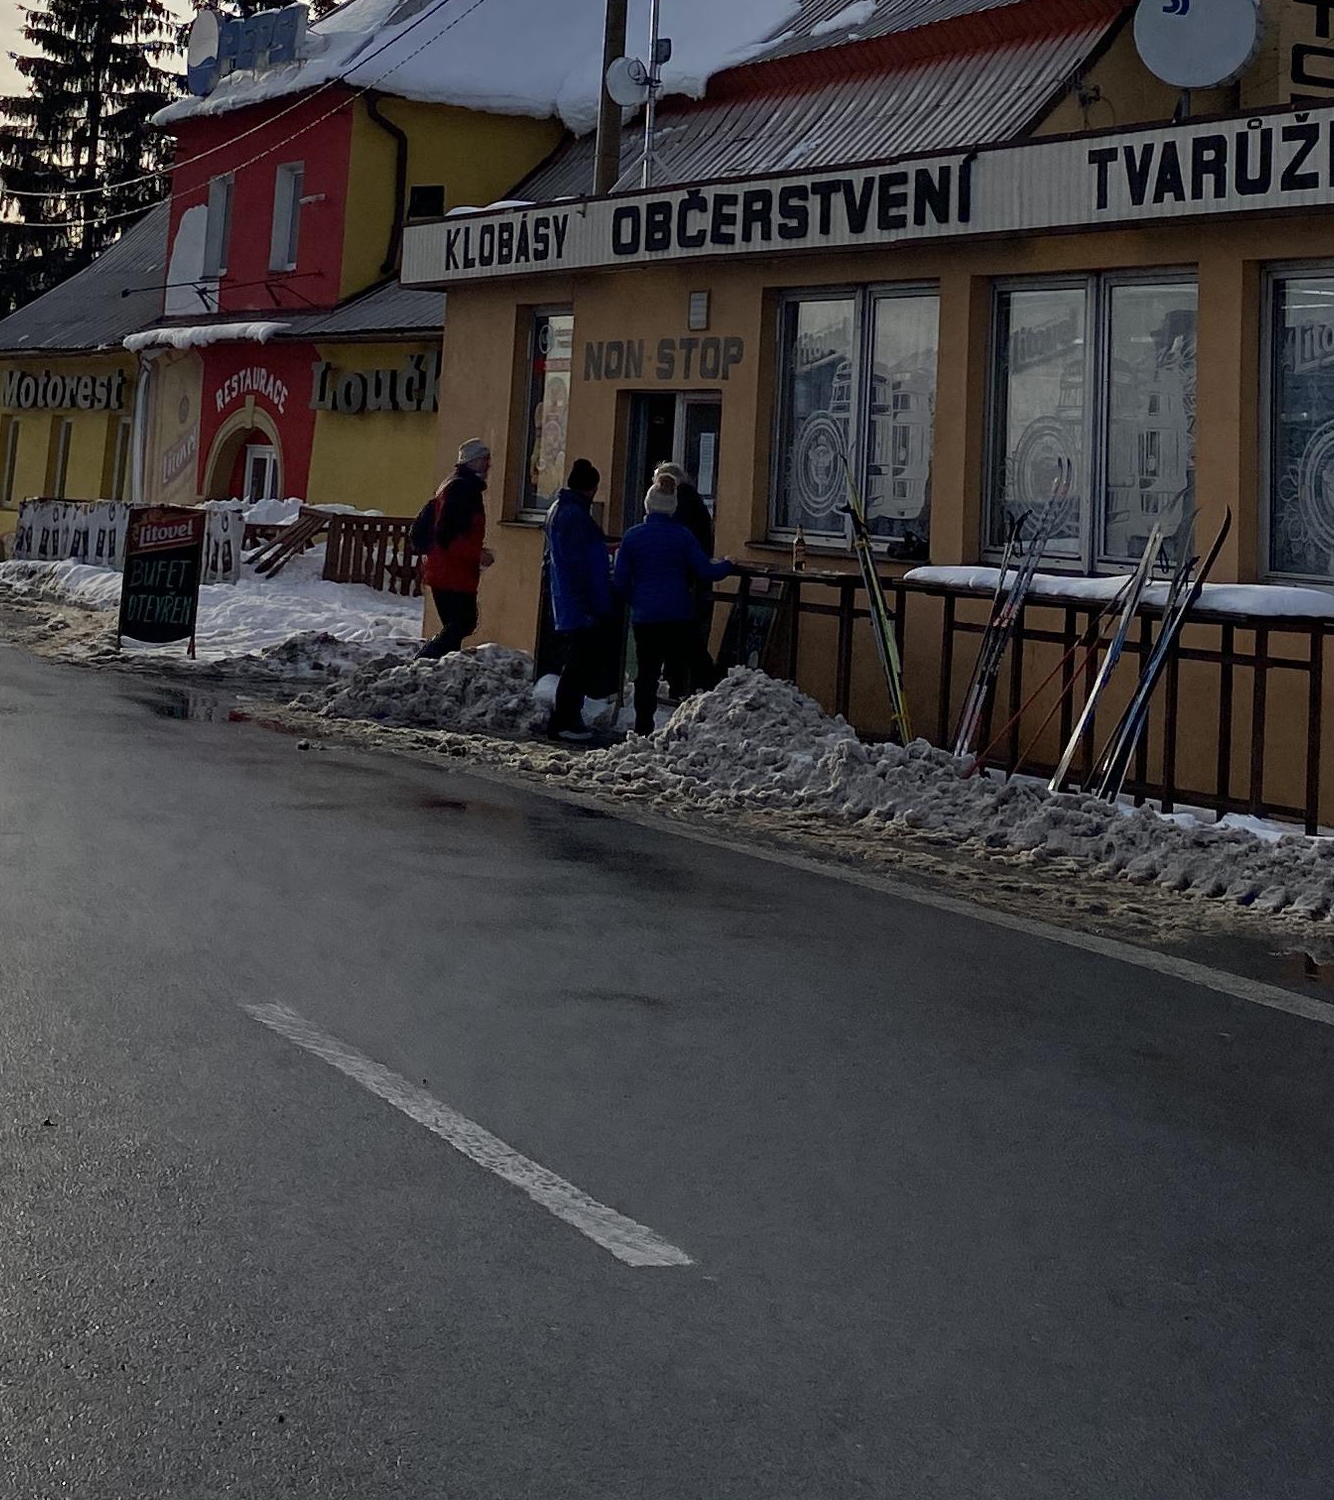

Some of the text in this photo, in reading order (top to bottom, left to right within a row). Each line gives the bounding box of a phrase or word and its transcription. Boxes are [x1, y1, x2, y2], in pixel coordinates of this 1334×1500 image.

[445, 211, 570, 271] KLOBÁSY
[611, 153, 977, 256] OBČERSTVENÍ
[584, 339, 645, 381] NON
[656, 336, 744, 380] STOP
[1, 368, 127, 410] Motorest
[214, 366, 290, 414] RESTAURACE
[139, 518, 194, 548] Litovel
[128, 559, 194, 588] BUFET
